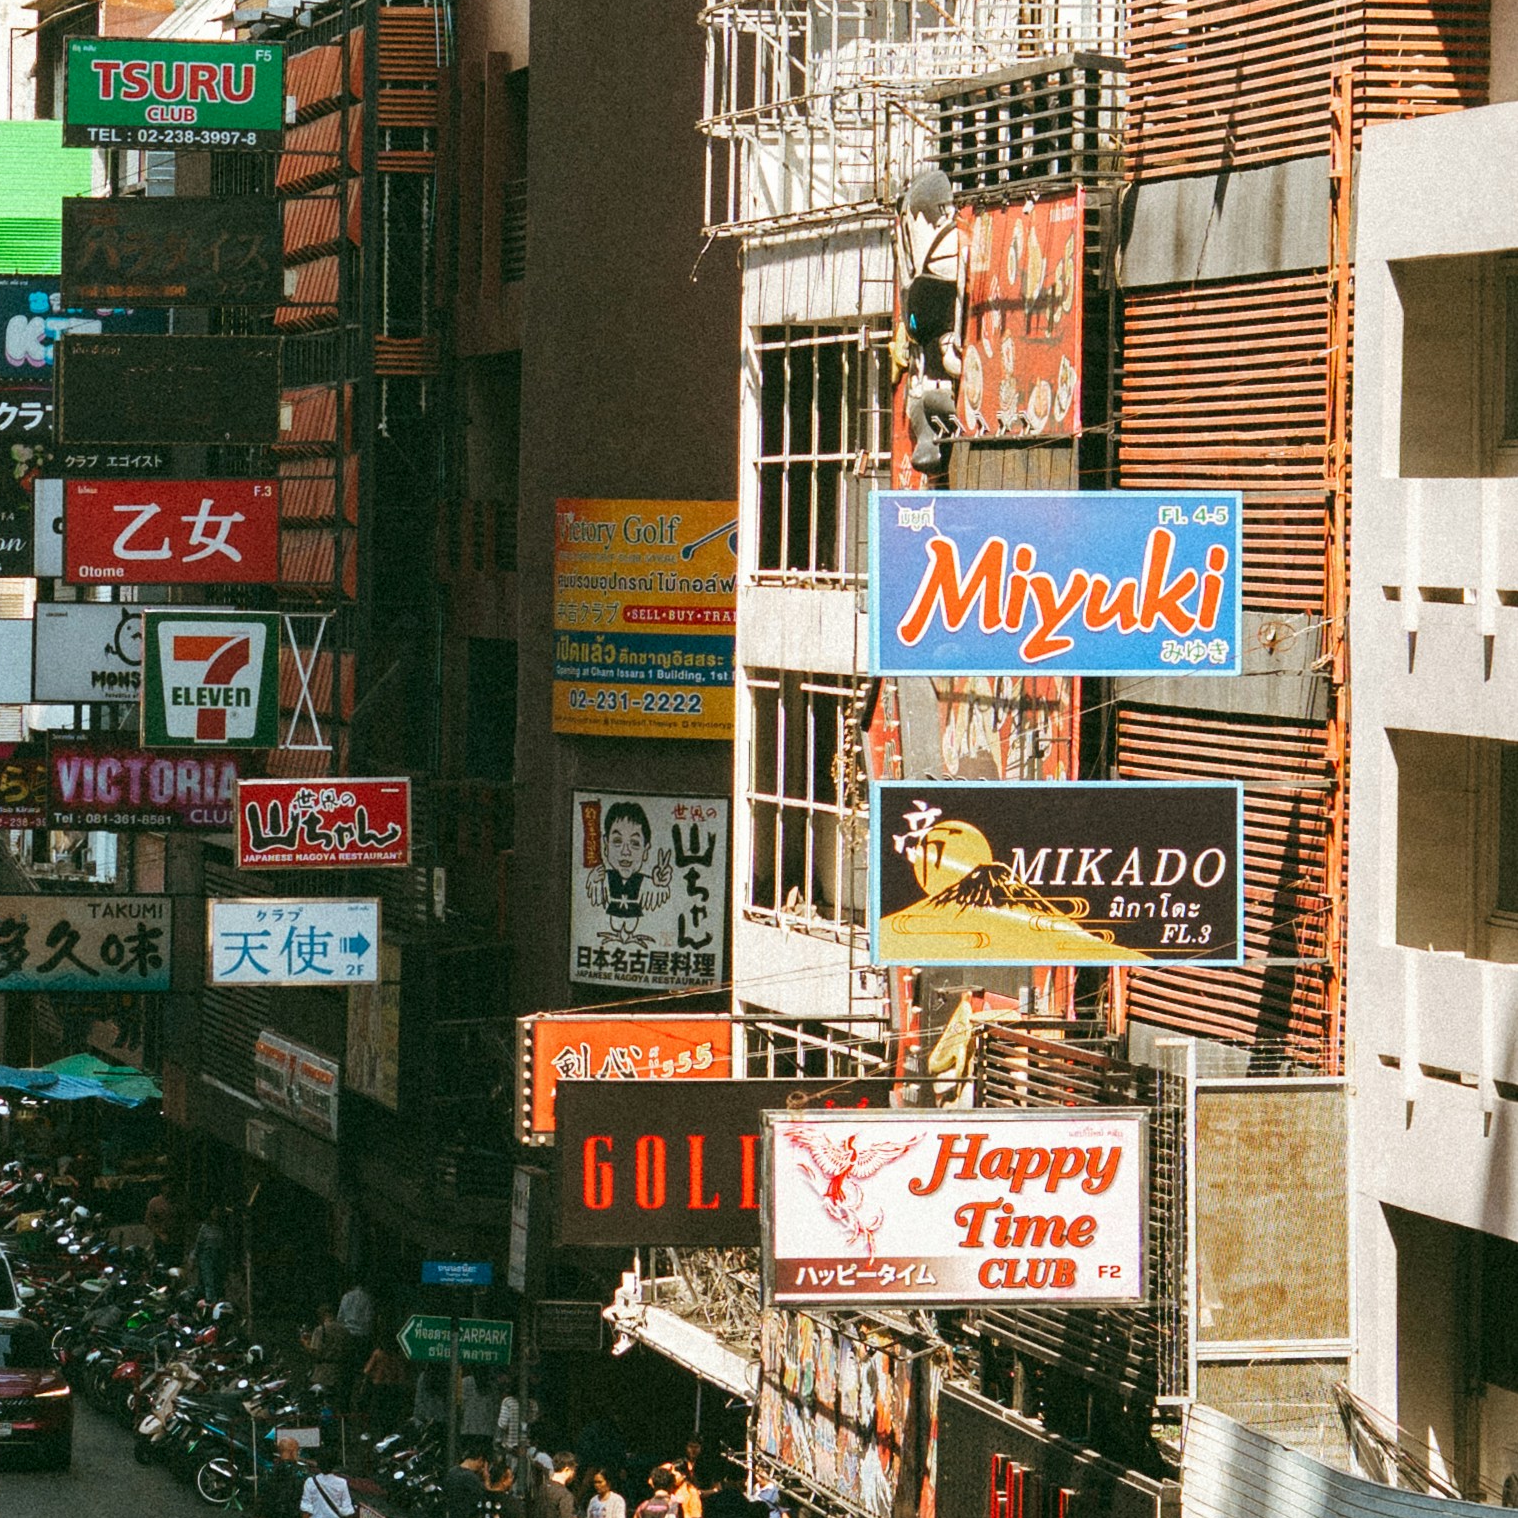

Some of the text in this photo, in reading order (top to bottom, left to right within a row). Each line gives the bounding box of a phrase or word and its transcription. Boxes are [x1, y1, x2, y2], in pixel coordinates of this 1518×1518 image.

[255, 49, 272, 61] F5
[91, 59, 256, 103] TSURU
[145, 104, 197, 123] CLUB
[87, 127, 121, 142] TEL
[138, 129, 256, 145] 02-238-3997-8
[65, 454, 162, 468] クラブ エゴイスト
[254, 485, 271, 497] F.3
[1192, 506, 1228, 525] 4-5
[113, 498, 245, 563] 乙女
[556, 512, 681, 550] Victory Golf
[79, 565, 124, 578] Otome
[897, 526, 1228, 663] Miyuki
[631, 609, 661, 621] SELL
[668, 610, 695, 621] BUY
[1161, 639, 1228, 664] みゆき
[173, 635, 251, 741] 7
[657, 669, 706, 683] Building,
[710, 670, 728, 681] 1st
[172, 686, 251, 707] ELEVEn
[569, 688, 703, 714] 02-231-2222
[57, 757, 238, 803] VICTORIA
[294, 788, 356, 812] 世界の
[54, 813, 73, 823] Tel
[671, 803, 717, 822] 世界の
[245, 800, 401, 853] 山ちゃん
[243, 850, 402, 863] JAPANESE NAGOYA RESTAURANT
[1005, 846, 1226, 888] MIKADO
[671, 822, 717, 950] 山ちゃん
[87, 902, 163, 919] TAKUMI
[1109, 893, 1201, 919] มิกาโดะ
[1160, 923, 1212, 945] FL.3
[219, 925, 334, 976] 天使
[577, 945, 716, 977] 日本名古屋料理
[346, 964, 364, 975] 2F
[575, 969, 714, 986] JAPANESE NAGOYA RESTAURANT
[660, 1042, 714, 1079] 555
[908, 1133, 1123, 1197] Happy
[954, 1196, 1098, 1249] Time
[795, 1263, 937, 1286] ハッピータイム
[978, 1258, 1122, 1289] CLUB F2
